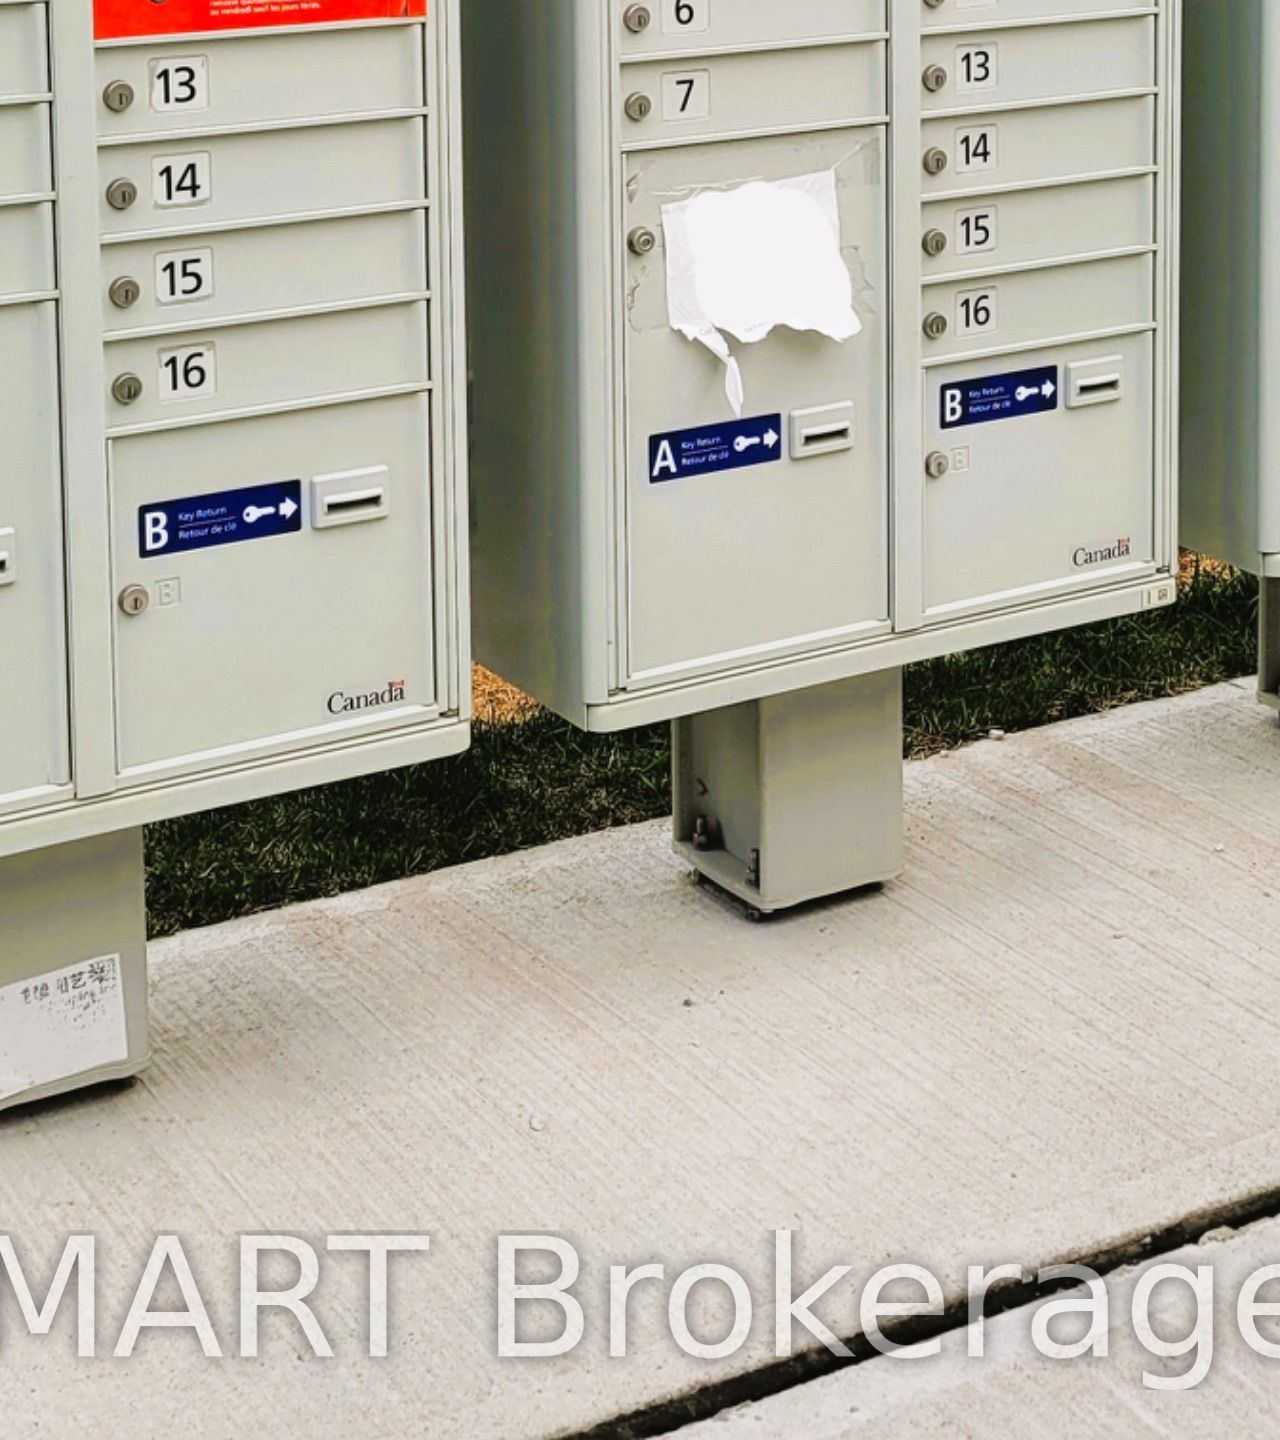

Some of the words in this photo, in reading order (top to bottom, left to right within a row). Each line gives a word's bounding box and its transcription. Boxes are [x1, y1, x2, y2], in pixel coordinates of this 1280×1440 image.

[962, 51, 989, 82] 13
[157, 67, 195, 103] 13
[676, 79, 693, 111] 7
[961, 133, 990, 164] 14
[160, 164, 200, 200] 14
[961, 215, 989, 246] 15
[162, 259, 202, 295] 15
[961, 295, 989, 327] 16
[165, 353, 205, 390] 16
[945, 388, 962, 422] B
[652, 440, 677, 476] A
[178, 511, 194, 523] Key
[196, 506, 227, 519] Return
[144, 511, 169, 551] B
[178, 528, 208, 539] Retour
[211, 525, 223, 534] de
[1073, 540, 1131, 568] Canada
[327, 685, 405, 716] Canada
